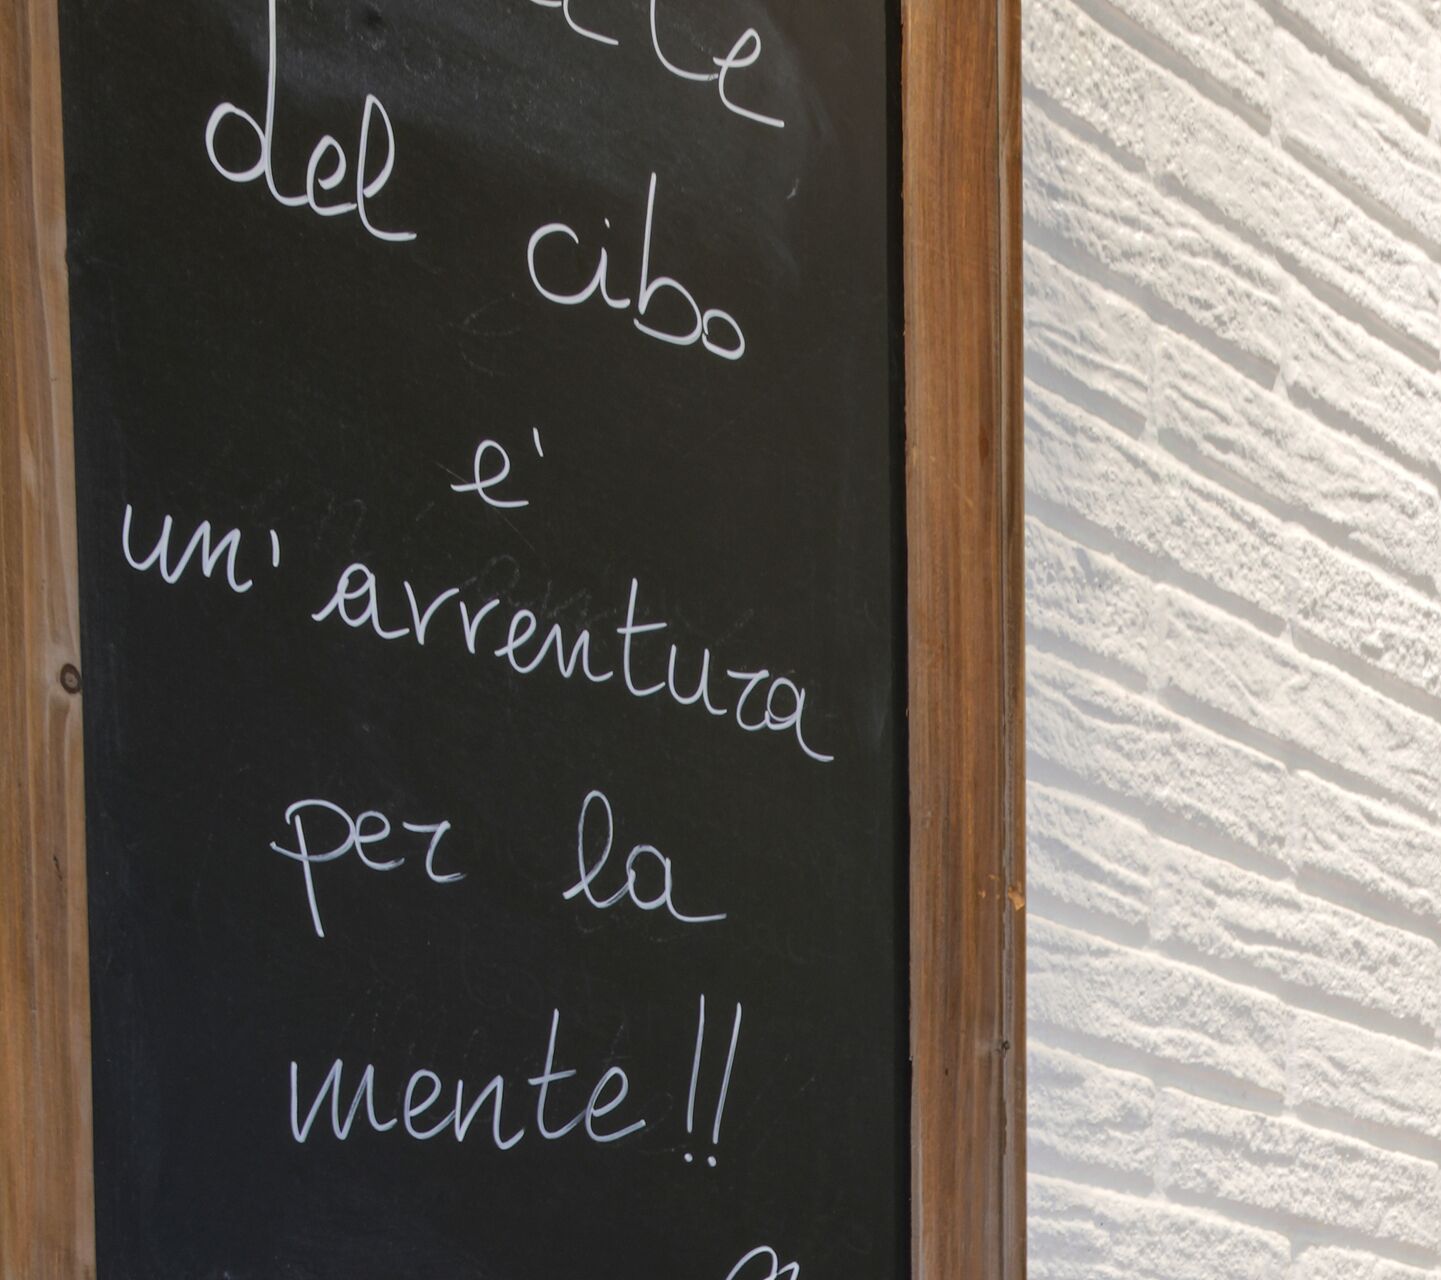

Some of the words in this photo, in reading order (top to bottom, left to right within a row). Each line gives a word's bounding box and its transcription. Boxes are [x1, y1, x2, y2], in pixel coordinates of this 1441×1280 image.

[205, 0, 417, 241] del
[527, 172, 746, 361] cibo
[269, 798, 467, 938] per
[562, 789, 728, 923] la
